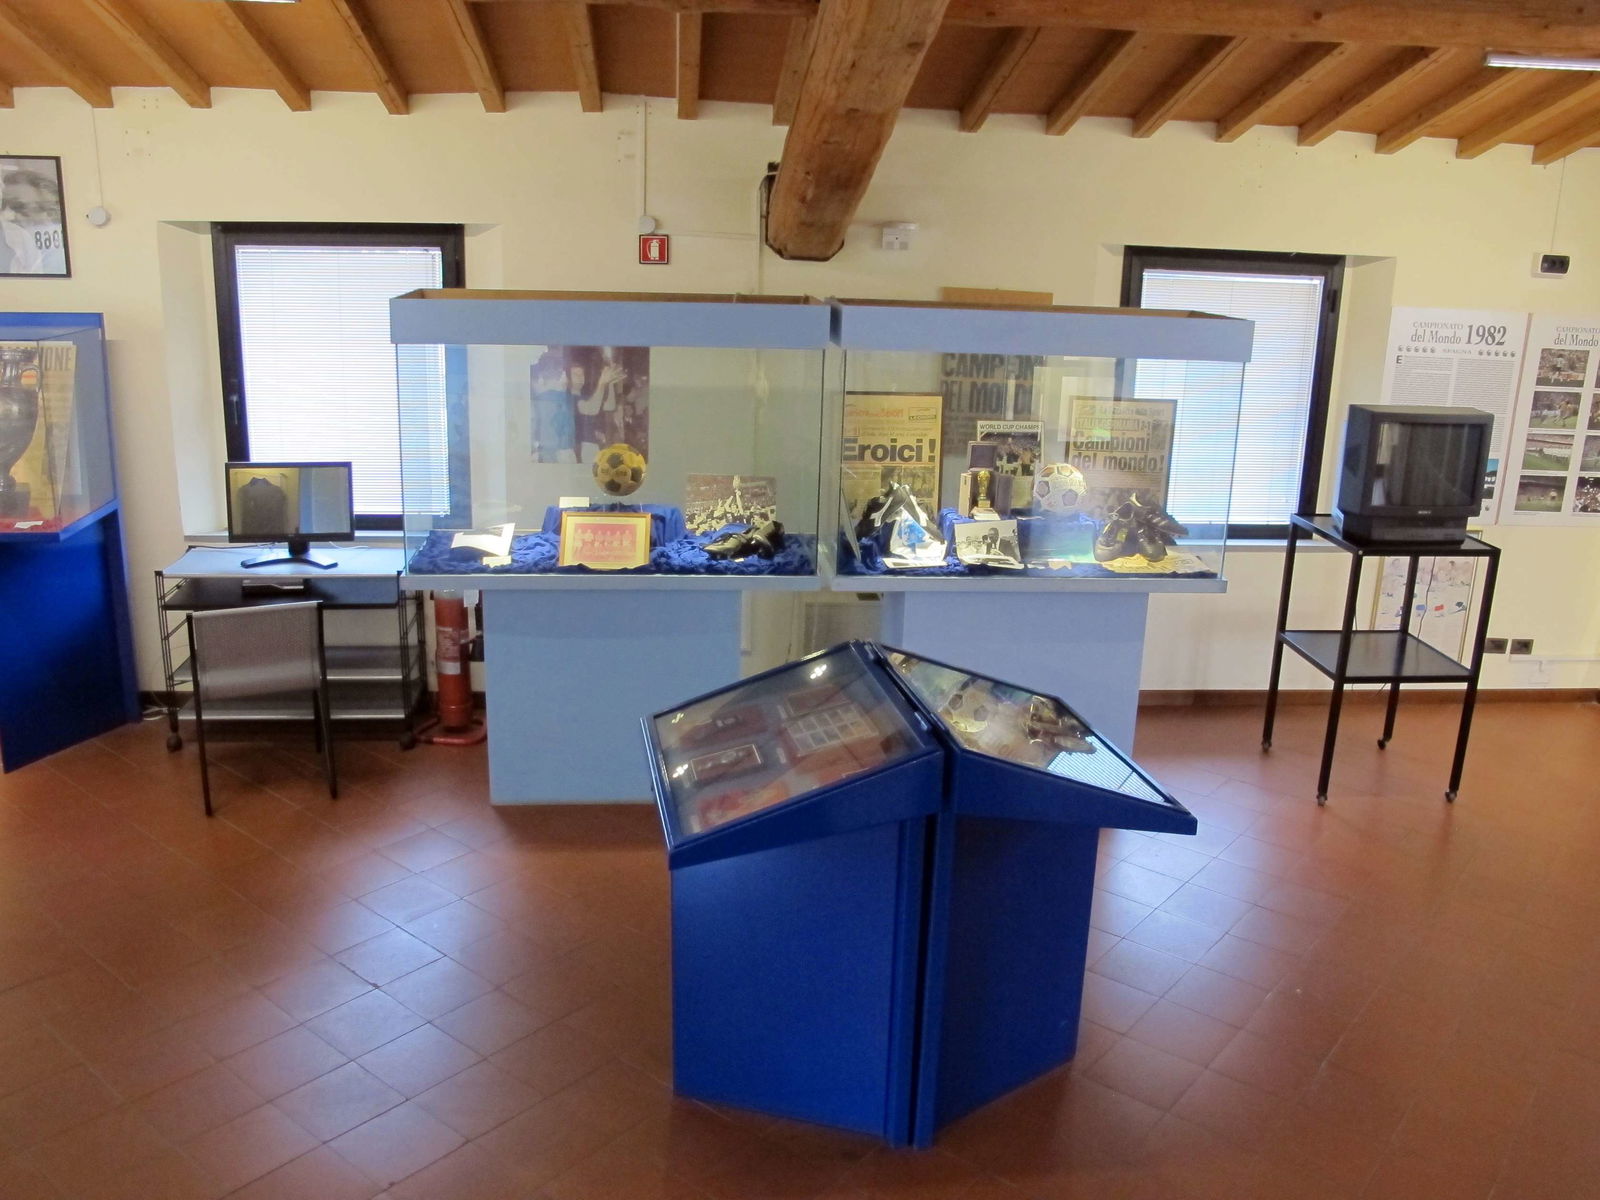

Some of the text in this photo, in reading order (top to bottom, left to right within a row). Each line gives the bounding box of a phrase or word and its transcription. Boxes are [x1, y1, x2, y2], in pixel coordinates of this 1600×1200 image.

[1410, 324, 1507, 346] del Mondo 1982
[1412, 321, 1464, 330] CAMPIONATO
[1554, 333, 1599, 347] del Mondo
[1072, 430, 1151, 450] Campioni
[1072, 451, 1165, 472] del mondo!
